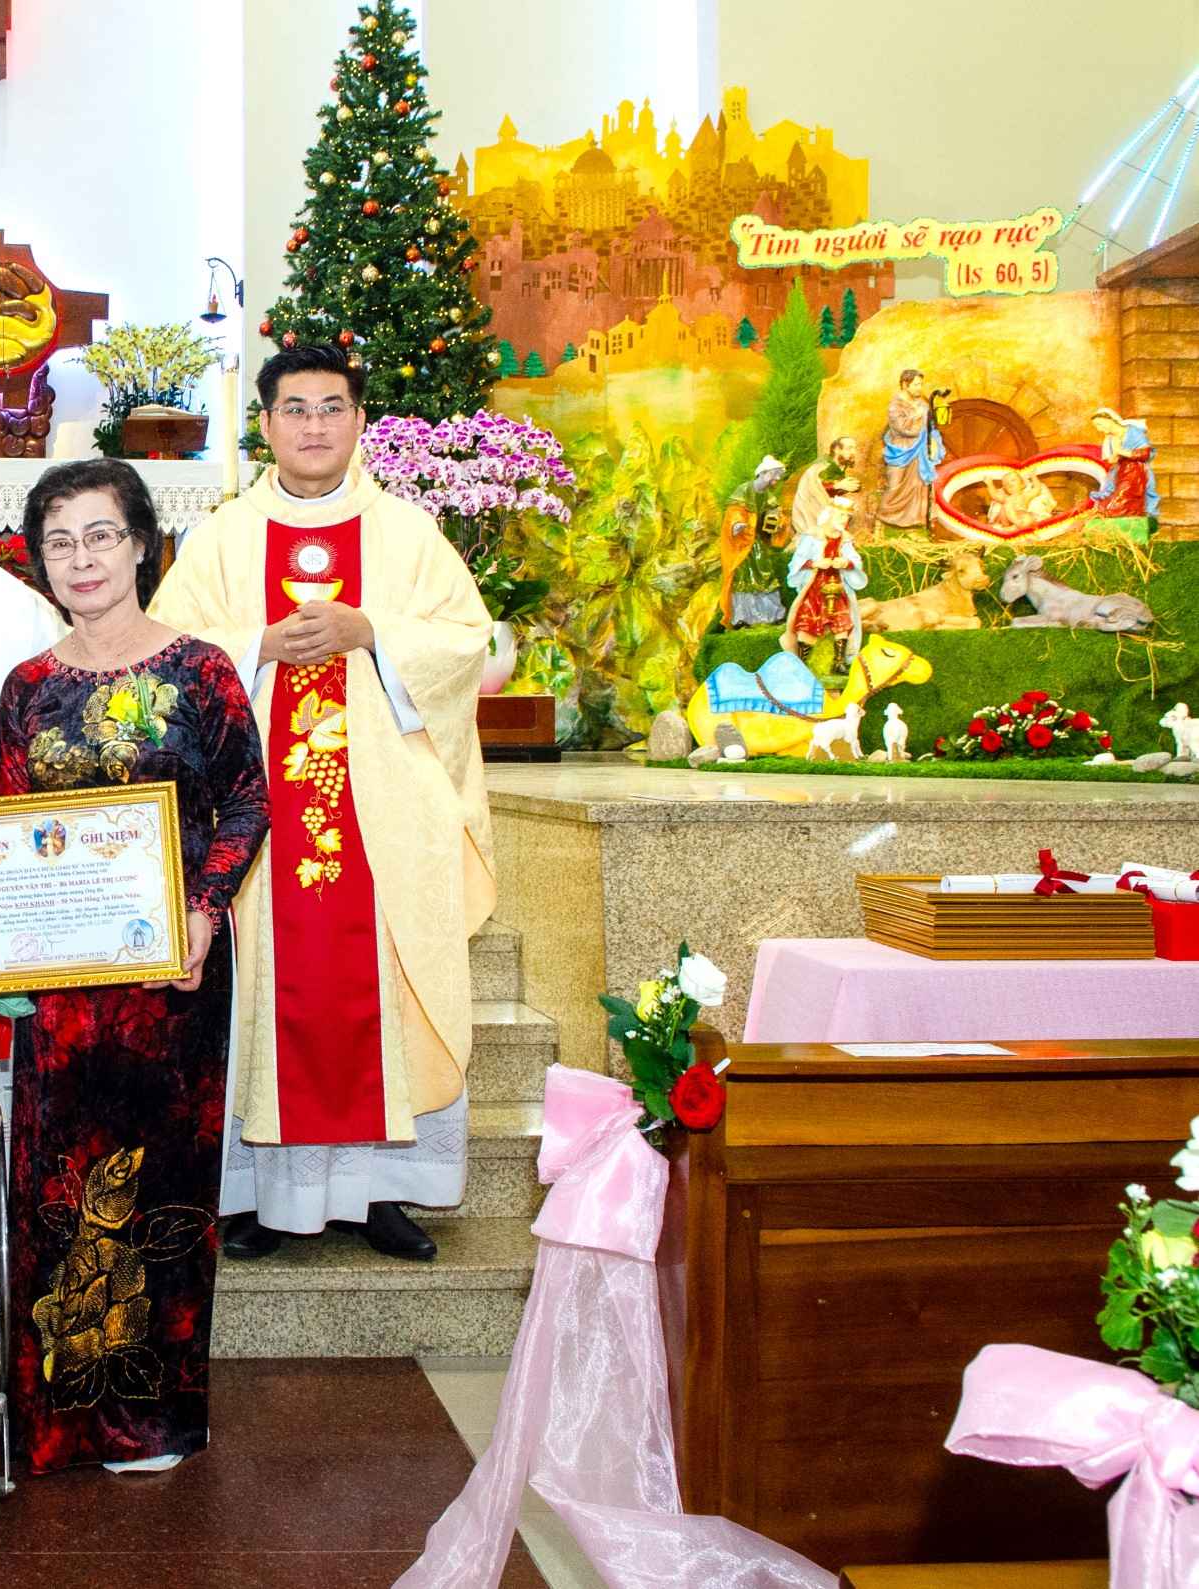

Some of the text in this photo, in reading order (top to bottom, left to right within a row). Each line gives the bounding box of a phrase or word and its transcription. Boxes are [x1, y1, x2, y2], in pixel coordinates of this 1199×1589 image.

[814, 226, 889, 257] ngươi
[901, 225, 930, 249] sẽ
[939, 228, 983, 252] rạo
[996, 261, 1023, 287] 60,
[1032, 258, 1050, 285] 5)
[81, 832, 103, 844] GHI
